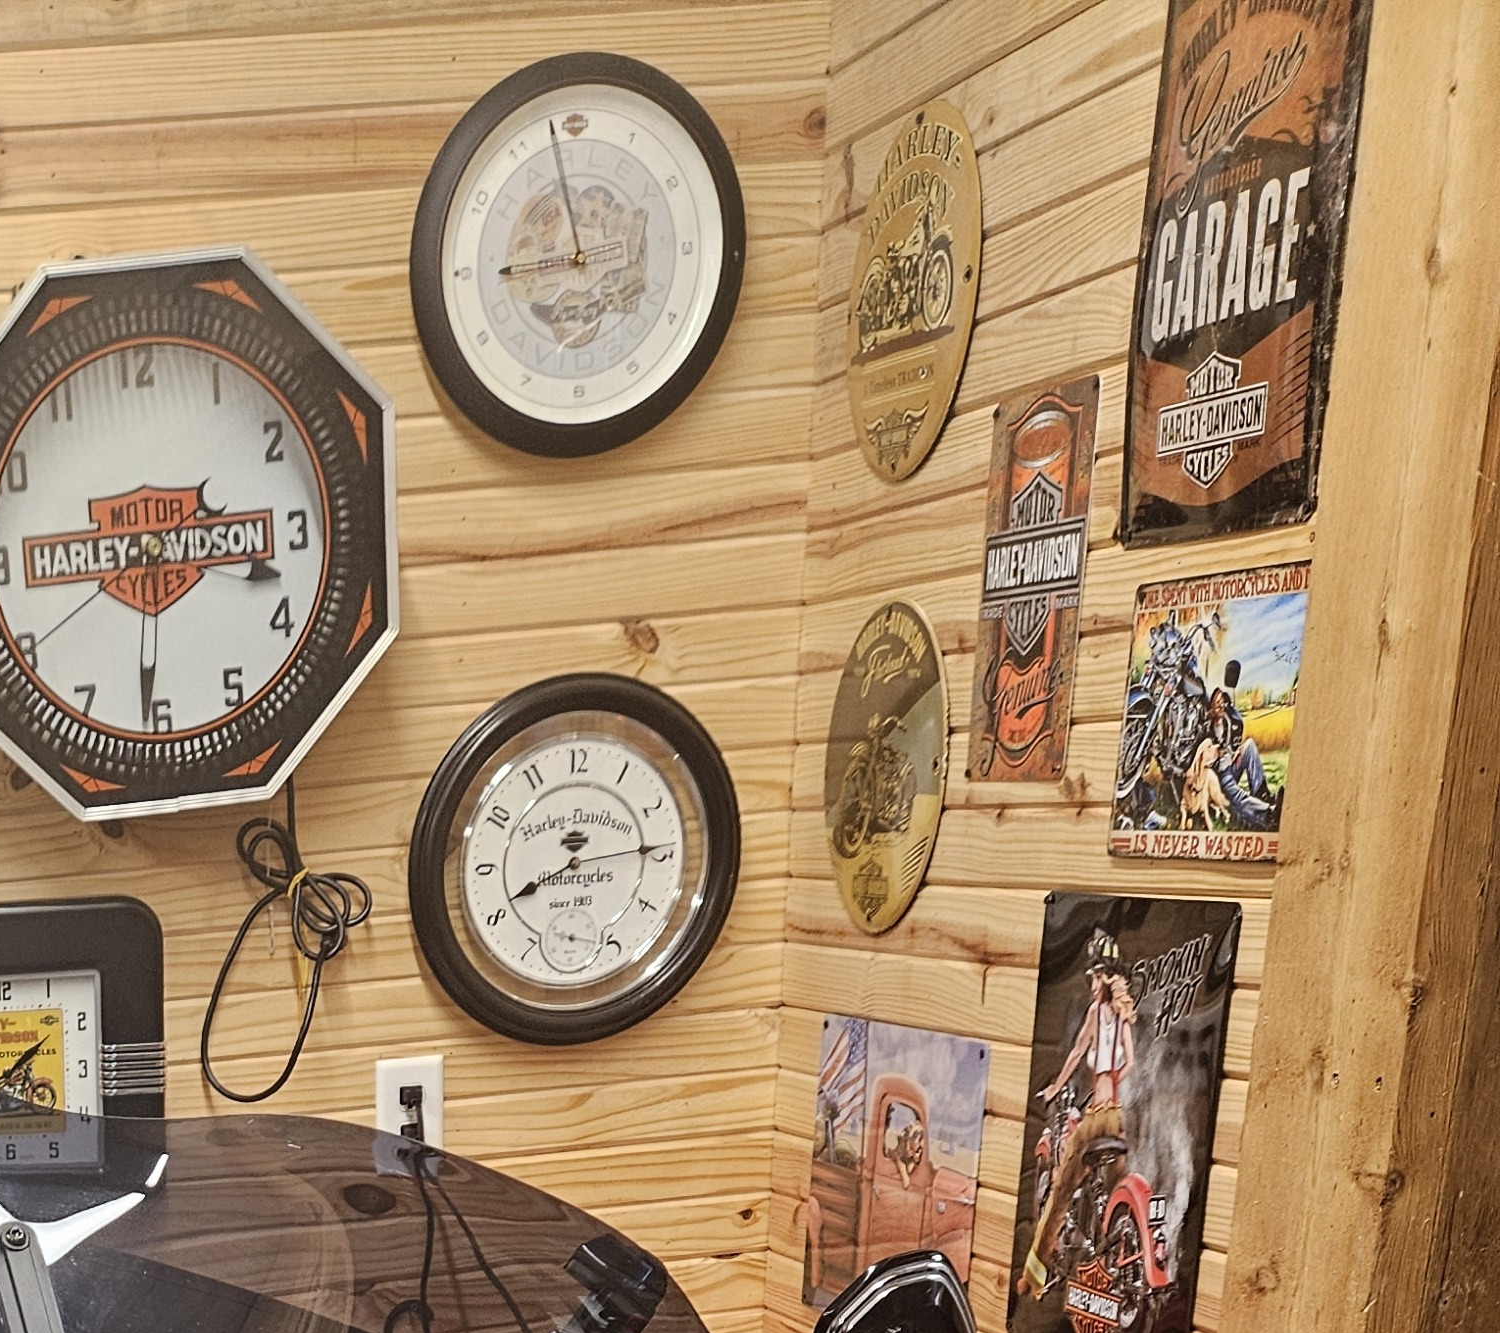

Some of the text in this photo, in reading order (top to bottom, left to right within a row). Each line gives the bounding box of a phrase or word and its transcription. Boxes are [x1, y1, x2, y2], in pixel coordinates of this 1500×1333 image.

[508, 140, 528, 160] 11
[628, 132, 636, 144] 1
[665, 174, 680, 192] 2
[1151, 166, 1311, 345] GARAGE
[490, 278, 666, 372] DAVIDSON
[667, 311, 679, 326] 4
[120, 346, 155, 389] 12
[519, 373, 532, 387] 7
[625, 360, 641, 376] 5
[1188, 358, 1234, 398] MOTOR
[212, 362, 221, 406] 1
[573, 384, 586, 400] 6
[50, 377, 74, 423] 11
[1160, 393, 1264, 448] HARLEY-DAVIDSON
[263, 420, 284, 464] 2
[1185, 445, 1230, 481] CYCLES
[110, 497, 185, 530] MOTOR
[1015, 489, 1056, 529] MOTOR
[287, 510, 310, 551] 3
[985, 532, 1081, 591] HARLEY-DAVIDSON
[1161, 585, 1187, 607] SPENT
[1188, 583, 1211, 604] WITH
[1211, 572, 1280, 602] MOTORCYCLES
[1281, 567, 1303, 592] AND
[269, 596, 295, 638] 4
[1007, 595, 1051, 640] CYCLES
[223, 667, 244, 707] 5
[74, 684, 97, 720] 7
[152, 699, 173, 734] 6
[569, 748, 589, 775] 12
[615, 760, 630, 785] 1
[522, 763, 544, 791] 11
[486, 805, 511, 830] 10
[643, 796, 663, 818] 2
[519, 807, 633, 844] Harley-Davidson
[651, 848, 675, 865] 3
[1132, 835, 1265, 859] IS NEVER WASTED
[474, 862, 498, 877] 9
[537, 866, 615, 888] Motorcycles
[638, 896, 658, 914] 4
[486, 908, 506, 928] 8
[520, 937, 538, 961] 7
[606, 933, 623, 957] 5
[45, 978, 51, 999] 1
[1154, 973, 1204, 1040] HOT
[77, 1012, 87, 1031] 2
[79, 1060, 88, 1079] 3
[80, 1105, 92, 1126] 4
[6, 1143, 17, 1161] 6
[48, 1142, 59, 1159] 5
